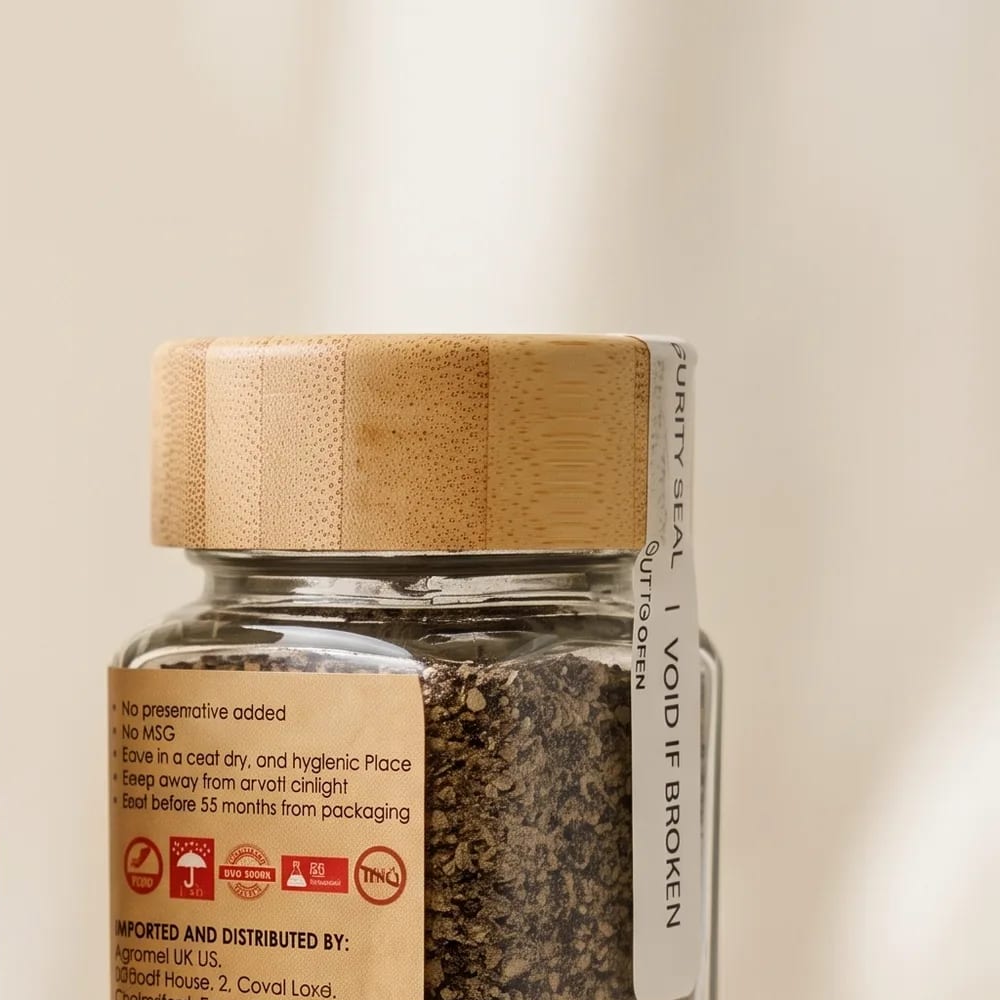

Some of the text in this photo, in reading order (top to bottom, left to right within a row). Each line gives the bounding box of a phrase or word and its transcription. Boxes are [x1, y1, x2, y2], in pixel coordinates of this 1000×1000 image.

[670, 479, 684, 569] SEAL
[663, 637, 680, 728] VOID
[122, 701, 286, 722] No added
[122, 724, 176, 742] No MSG
[157, 747, 169, 764] in
[173, 752, 182, 765] a
[224, 750, 251, 771] dry,
[365, 754, 412, 772] Place
[665, 740, 680, 768] IF
[159, 775, 199, 793] away
[203, 773, 235, 790] from
[152, 794, 196, 812] before
[201, 797, 218, 813] 55
[222, 799, 277, 816] months
[281, 800, 316, 817] from
[321, 801, 410, 824] packaging
[665, 780, 681, 929] BROKEN
[115, 920, 349, 951] IMPORTED AND DISTRIBUTED BY:
[115, 943, 222, 968] Agromel UK US.
[237, 976, 286, 996] Coval
